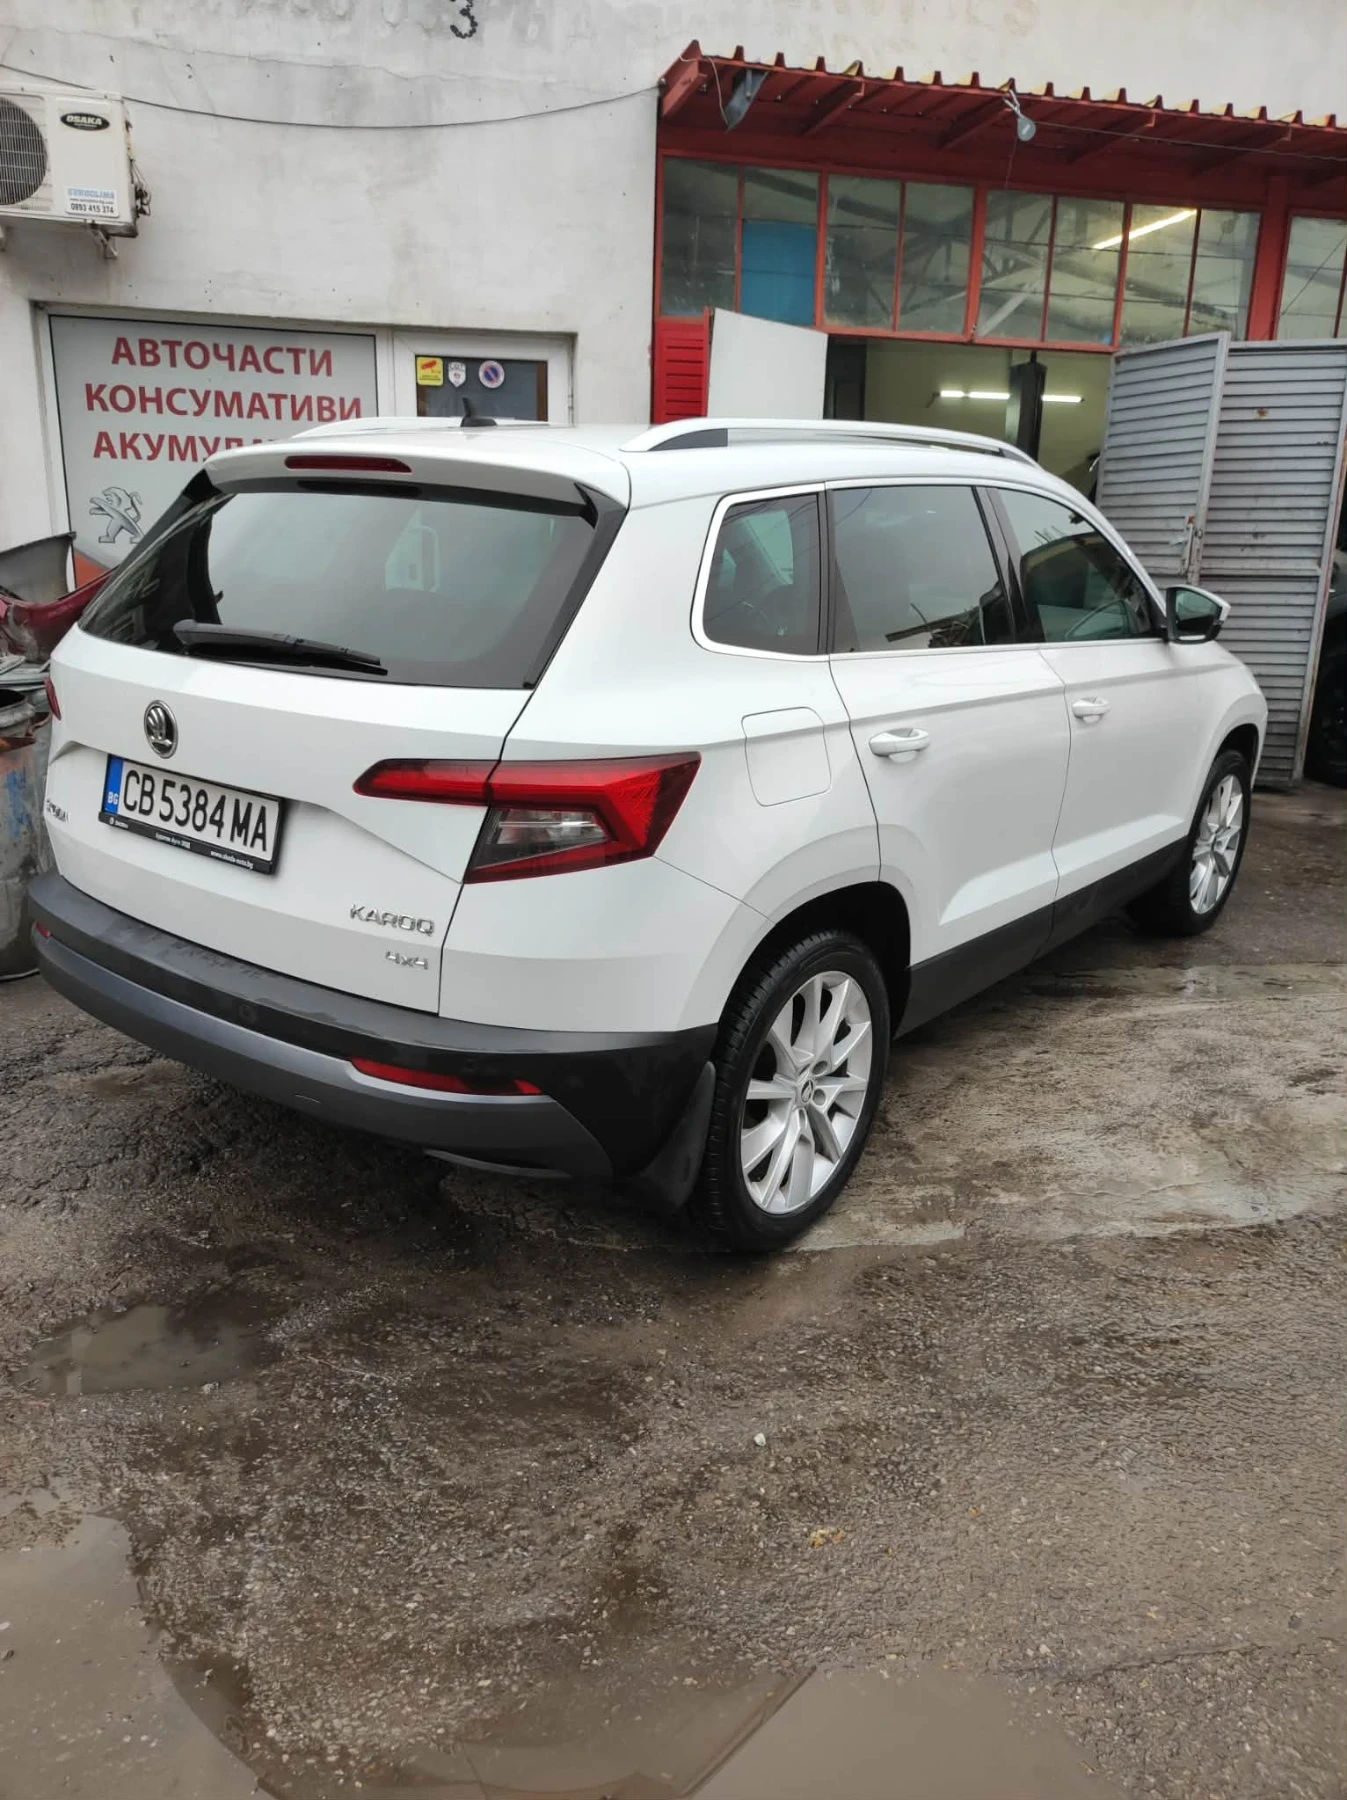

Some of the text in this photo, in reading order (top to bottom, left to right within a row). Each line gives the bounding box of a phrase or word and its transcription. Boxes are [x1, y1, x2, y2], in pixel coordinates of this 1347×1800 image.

[66, 115, 103, 125] OSAKA
[111, 337, 333, 377] АВТОЧАСТИ
[85, 383, 362, 423] КОНСУМАТИВИ
[107, 791, 119, 805] BG
[350, 904, 435, 937] KAROQ
[385, 951, 428, 970] 4x4
